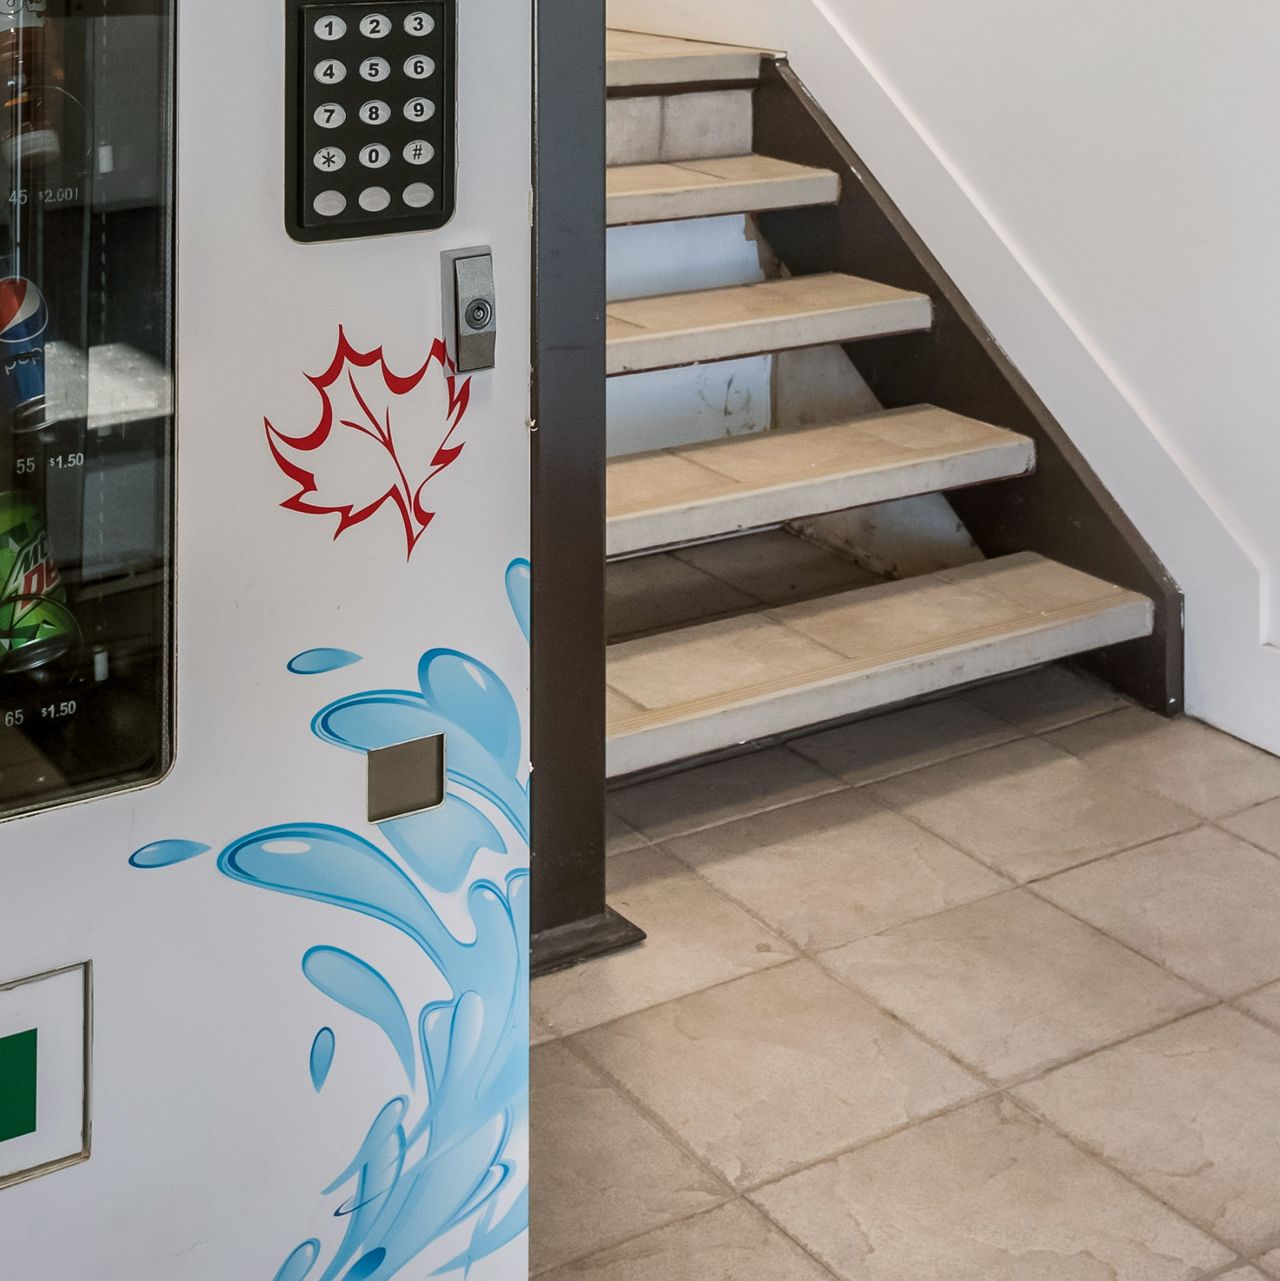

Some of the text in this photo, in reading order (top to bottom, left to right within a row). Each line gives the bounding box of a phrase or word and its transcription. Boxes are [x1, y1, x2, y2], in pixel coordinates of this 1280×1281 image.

[324, 17, 424, 36] 1 2 3
[323, 60, 425, 79] 4 5 6
[323, 102, 425, 123] 7 8 9
[368, 148, 380, 163] 0
[8, 187, 73, 206] 45 $2.00
[16, 453, 85, 475] 55 $1.50
[4, 700, 77, 727] 65 $1.50
